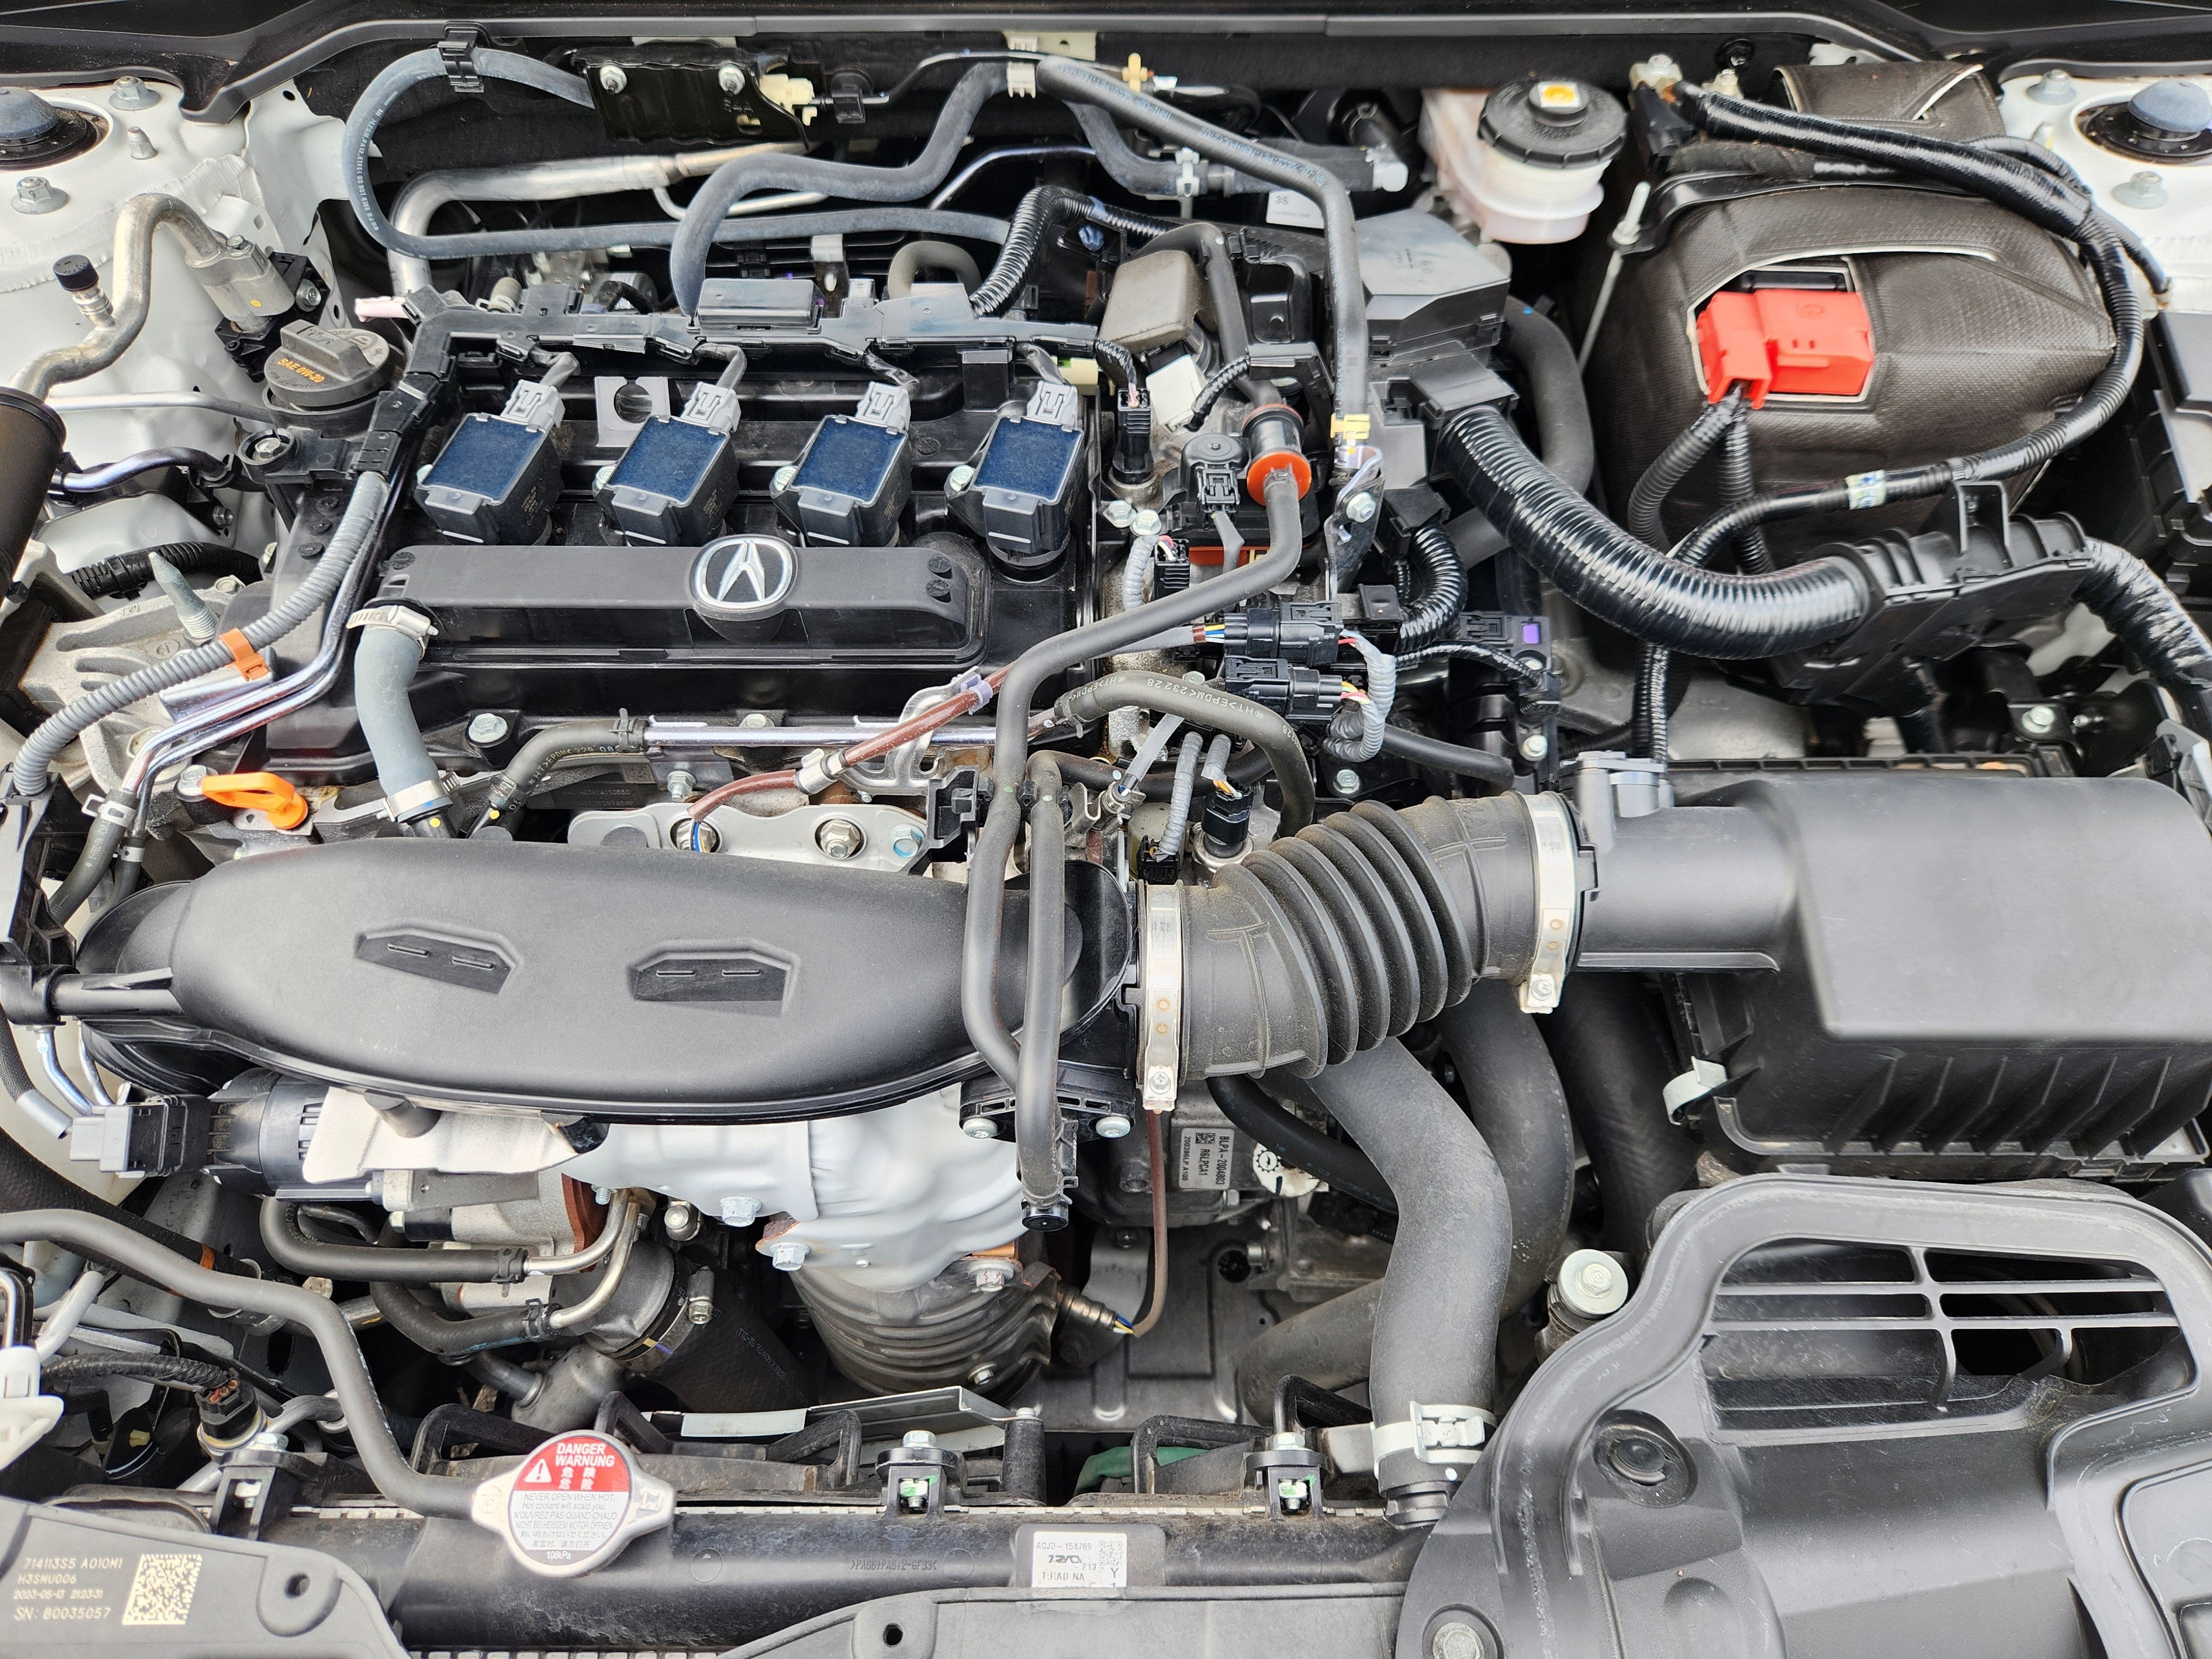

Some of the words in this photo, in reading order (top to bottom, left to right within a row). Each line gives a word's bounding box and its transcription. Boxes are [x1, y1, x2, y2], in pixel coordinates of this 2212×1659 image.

[278, 358, 300, 371] SAE
[296, 367, 325, 383] 0W-20
[1183, 1136, 1191, 1165] 2003B6LP
[1198, 1149, 1211, 1175] R6LPCA1
[556, 1443, 606, 1455] DANGER
[556, 1455, 615, 1468] WARNUNG
[561, 1502, 572, 1510] will
[592, 1512, 619, 1520] CHAUD.
[515, 1521, 531, 1529] NICHT
[546, 1551, 572, 1560] 108kPa
[1073, 1573, 1085, 1581] NA
[1111, 1567, 1119, 1578] Y
